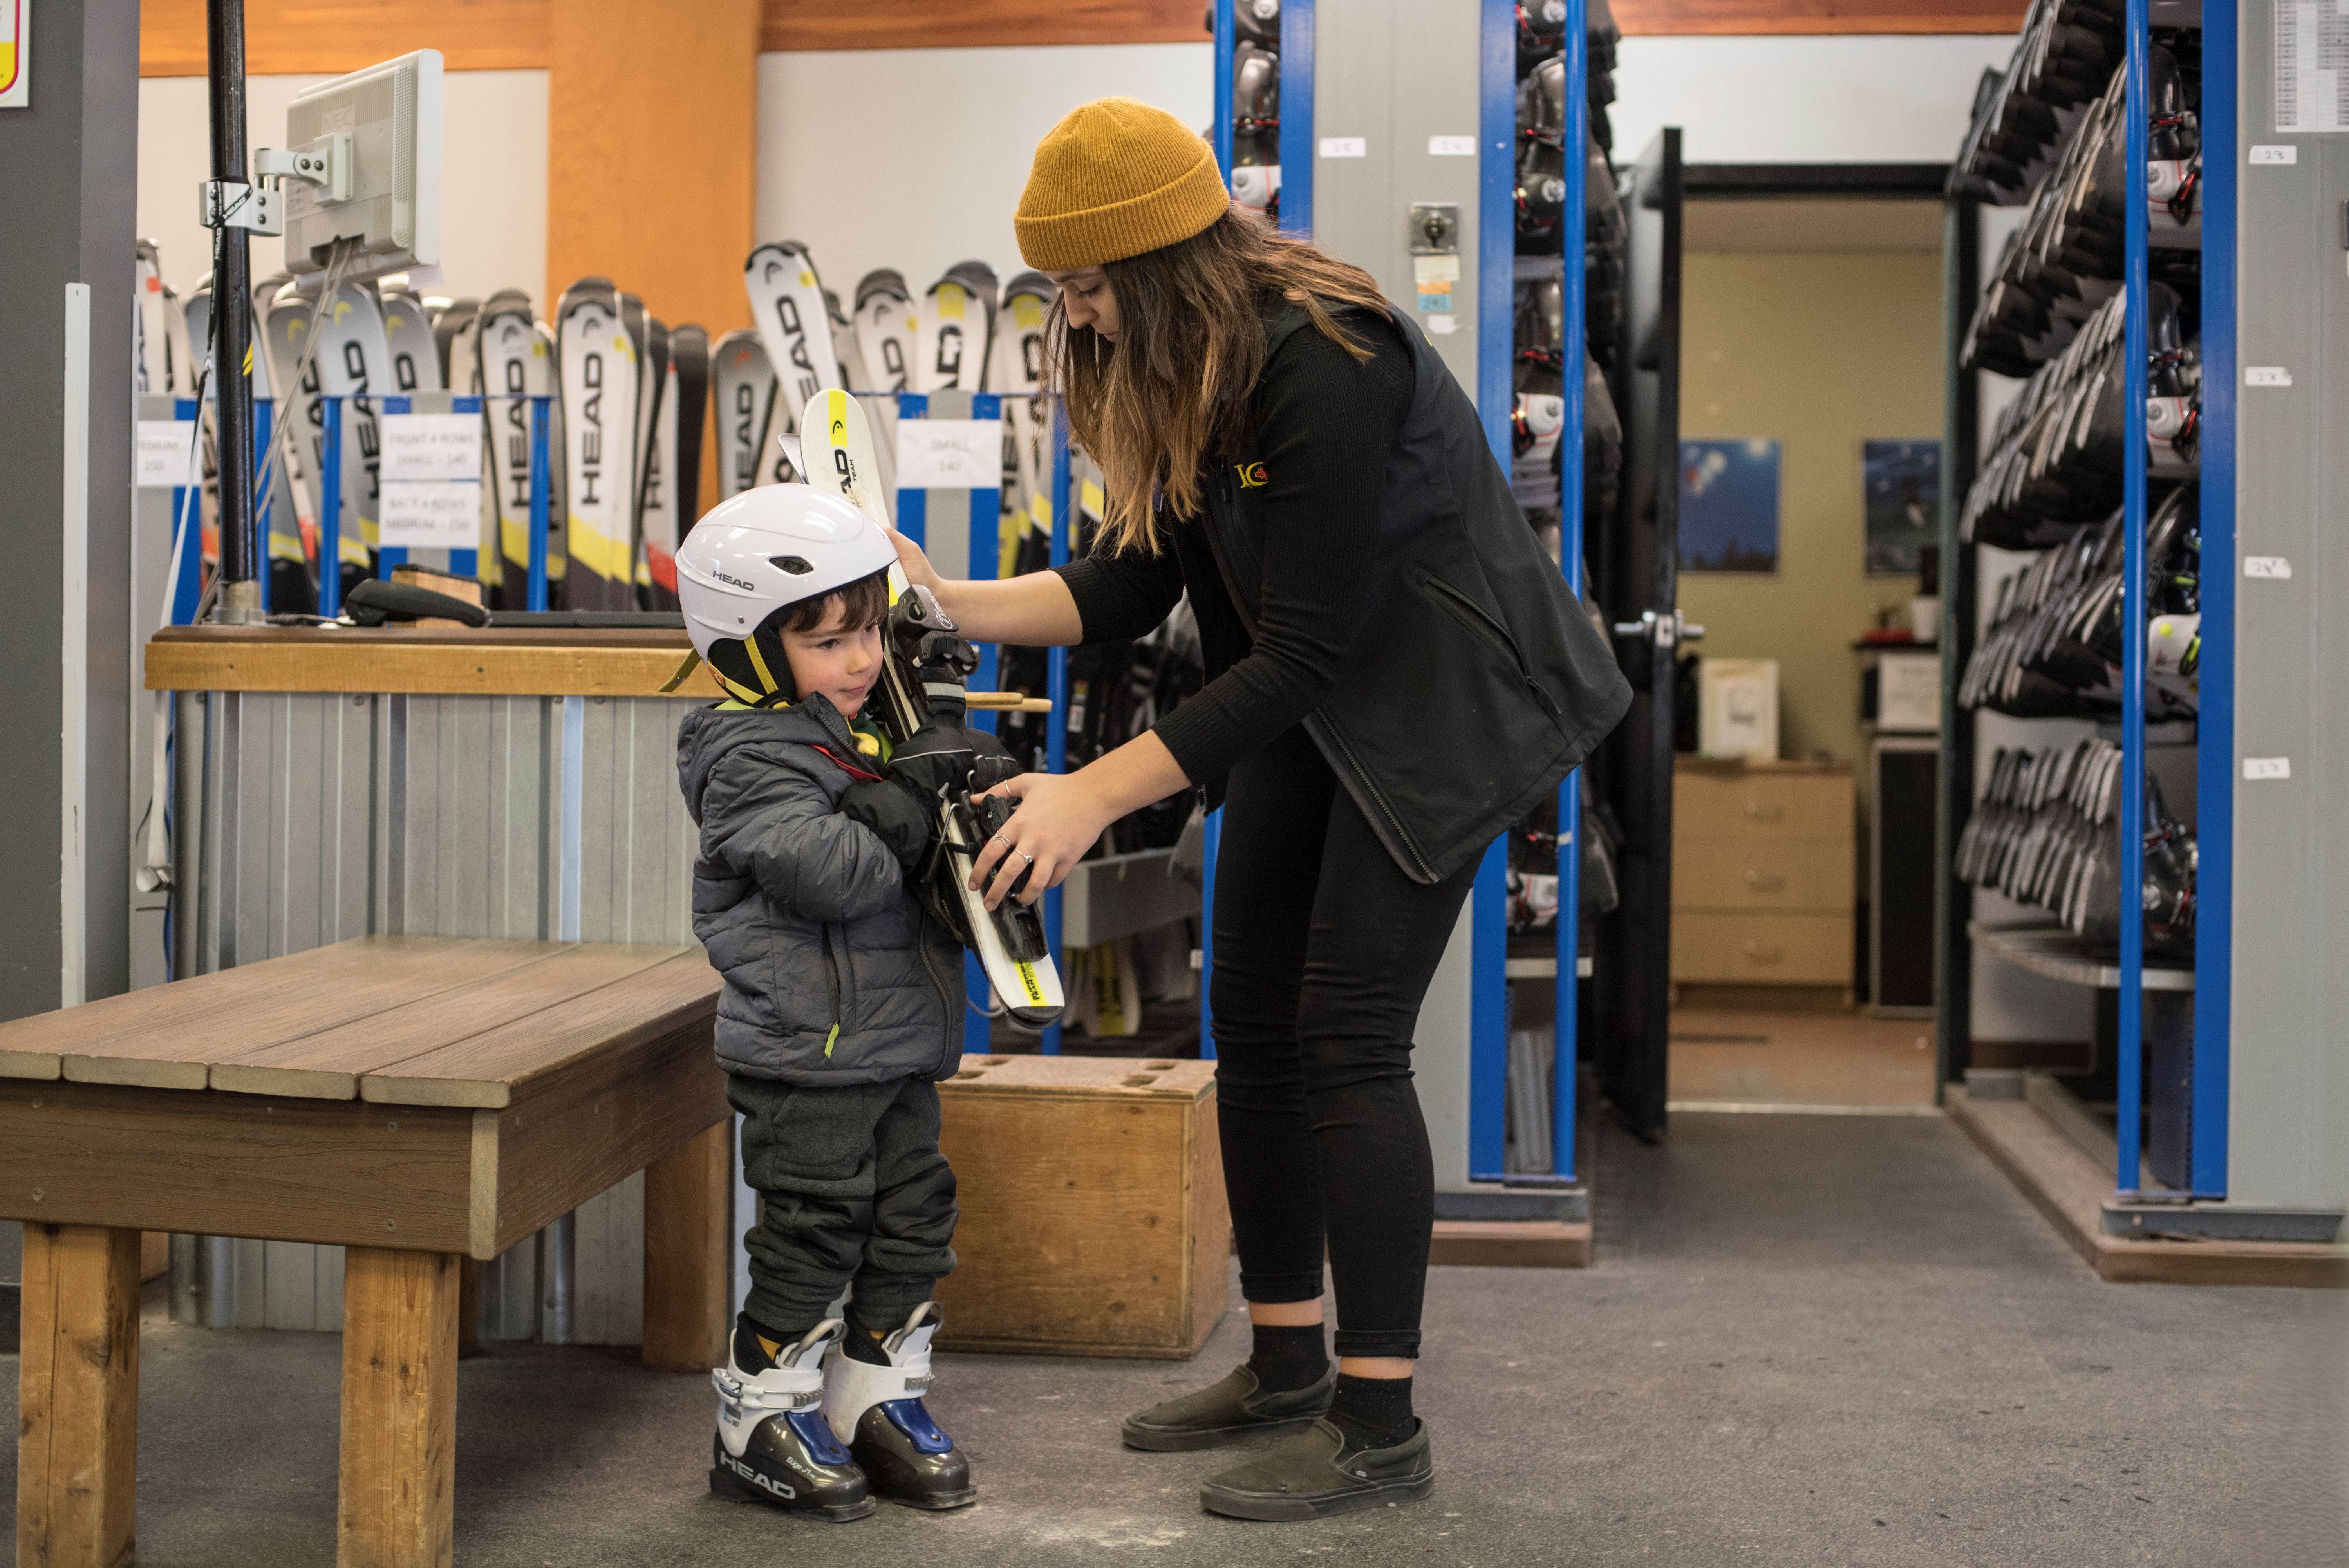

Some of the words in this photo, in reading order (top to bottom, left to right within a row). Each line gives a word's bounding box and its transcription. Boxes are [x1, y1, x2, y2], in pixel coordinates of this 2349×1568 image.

[323, 108, 352, 133] NEC
[2265, 150, 2284, 159] 23
[222, 197, 246, 219] HEAD
[776, 295, 820, 403] EAD
[506, 358, 530, 507] HEAD
[581, 353, 603, 504] HEAD
[736, 383, 752, 491] EAD
[137, 440, 178, 451] EDIUM
[931, 439, 970, 452] SMALL
[712, 570, 754, 591] HEAD
[786, 1456, 802, 1470] Edge
[720, 1451, 796, 1499] HEAD
